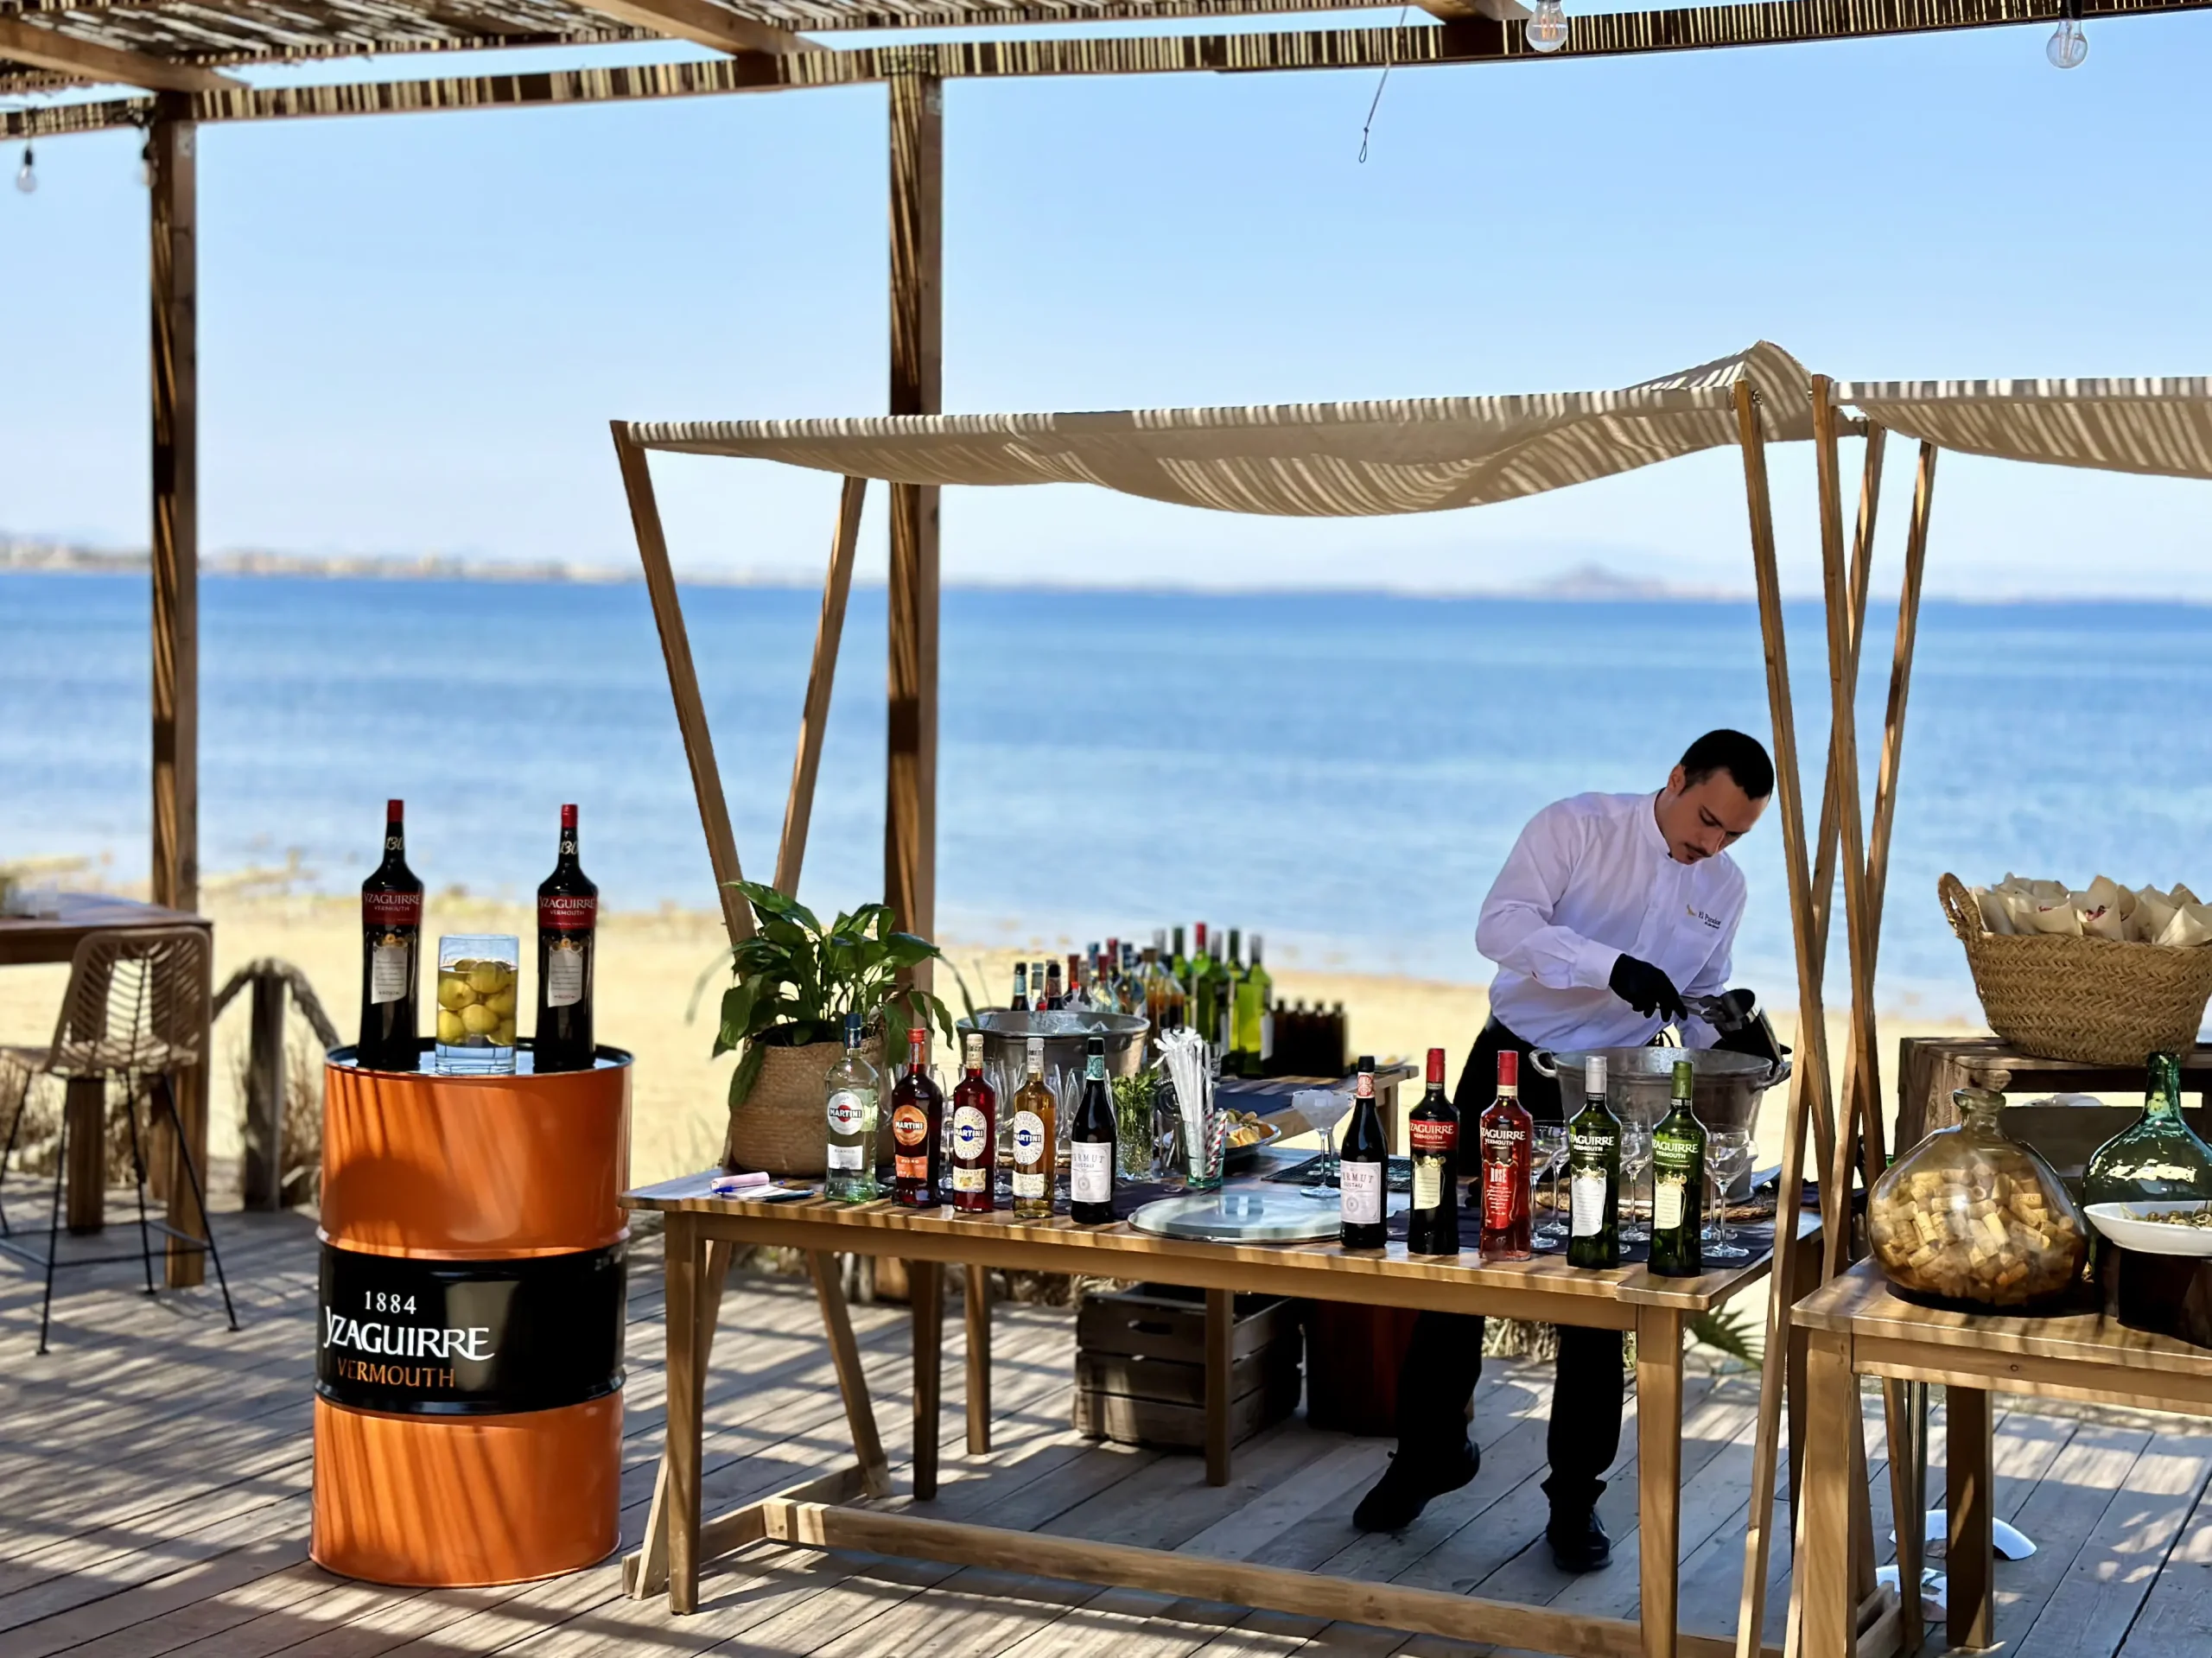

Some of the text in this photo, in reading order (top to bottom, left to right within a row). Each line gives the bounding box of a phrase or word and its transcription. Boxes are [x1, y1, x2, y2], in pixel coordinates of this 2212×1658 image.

[830, 1109, 862, 1119] MARTINI
[895, 1121, 923, 1130] MARTINI
[1410, 1123, 1454, 1134] ZAGUIRRE
[1480, 1127, 1526, 1140] ZAGUIRRE
[1569, 1134, 1615, 1146] ZAGUIRRE
[1652, 1139, 1699, 1153] ZAGUIRRE
[1072, 1153, 1105, 1164] ERMUT
[1656, 1150, 1687, 1159] VERMOUTH
[365, 1291, 416, 1314] 1884
[323, 1305, 495, 1361] YZAGUIRRE
[337, 1356, 455, 1388] VERMOUTH
